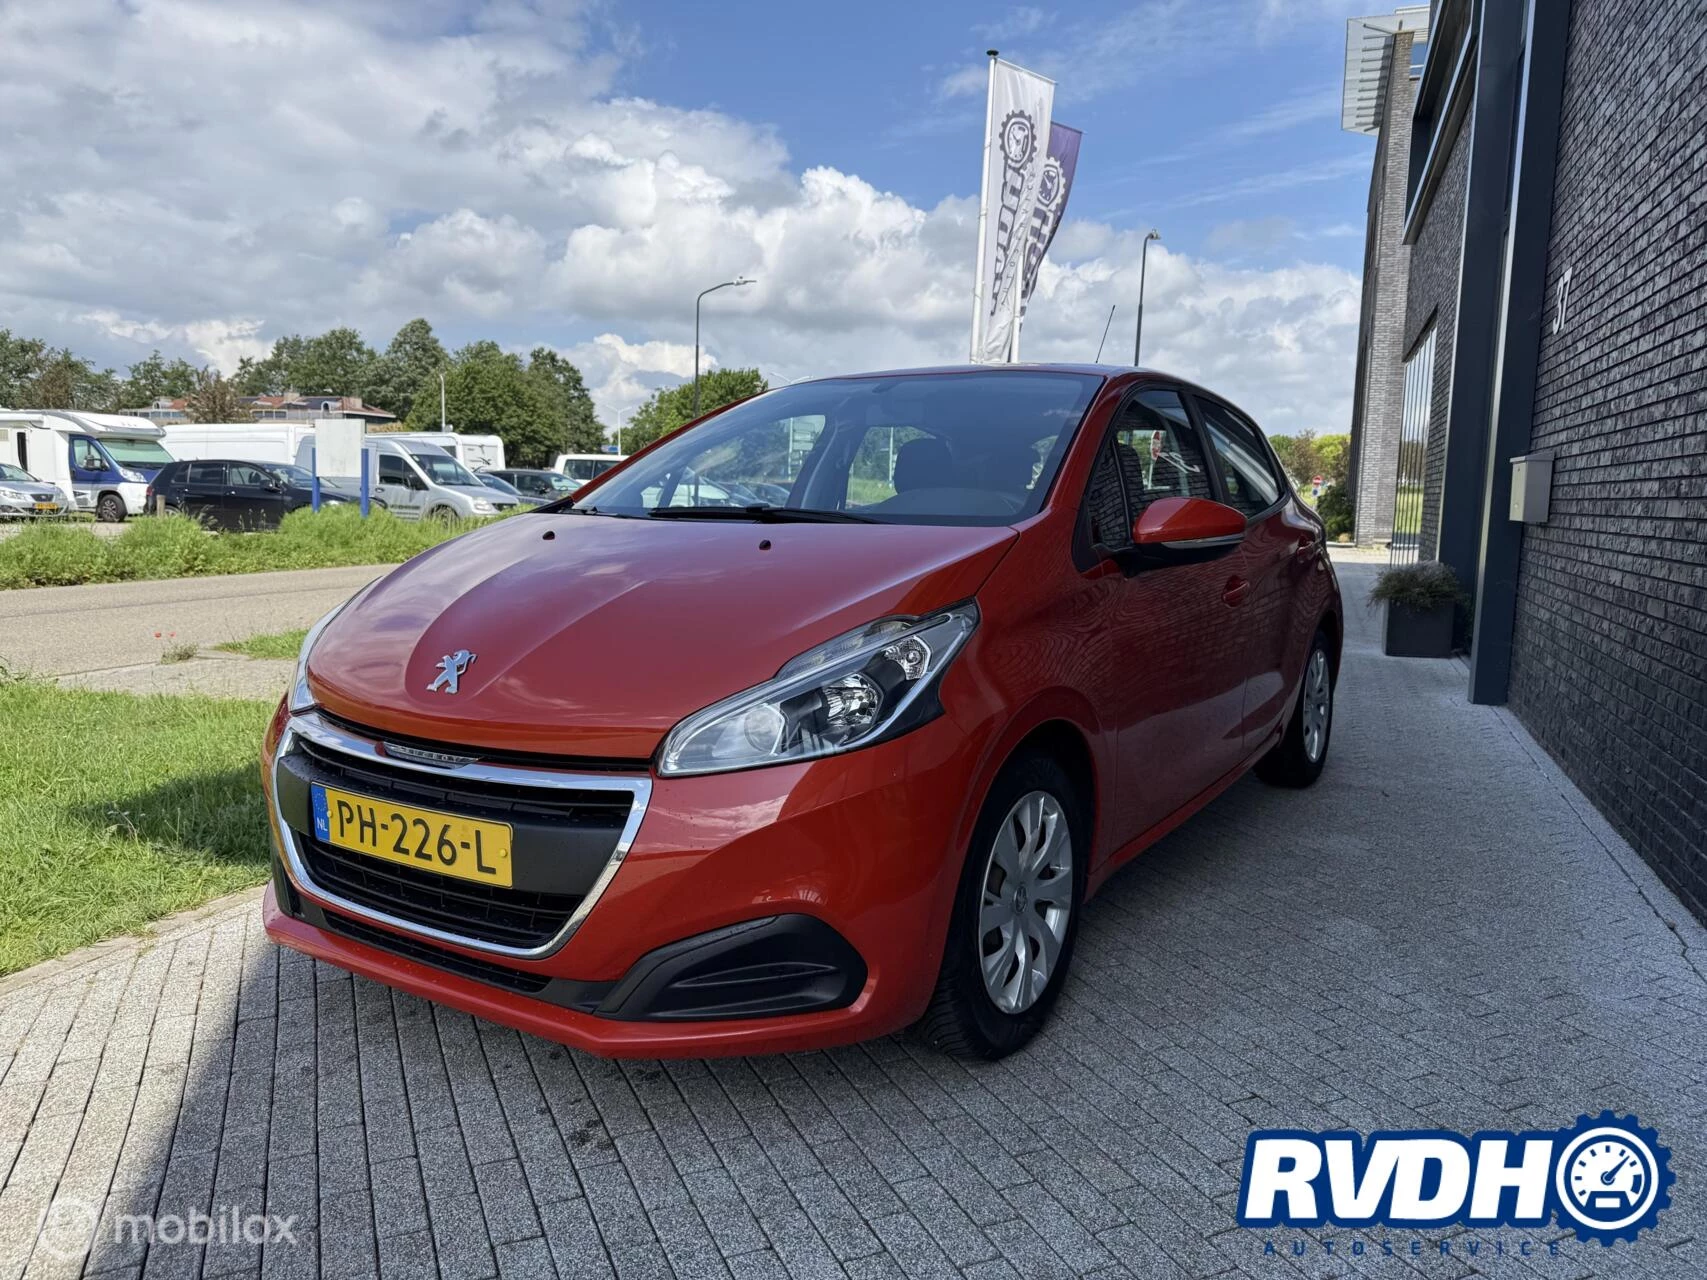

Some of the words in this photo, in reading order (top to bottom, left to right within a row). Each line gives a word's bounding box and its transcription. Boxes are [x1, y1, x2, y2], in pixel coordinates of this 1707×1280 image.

[1552, 266, 1573, 335] 37
[316, 816, 329, 832] NL
[337, 799, 497, 875] PH-226-L
